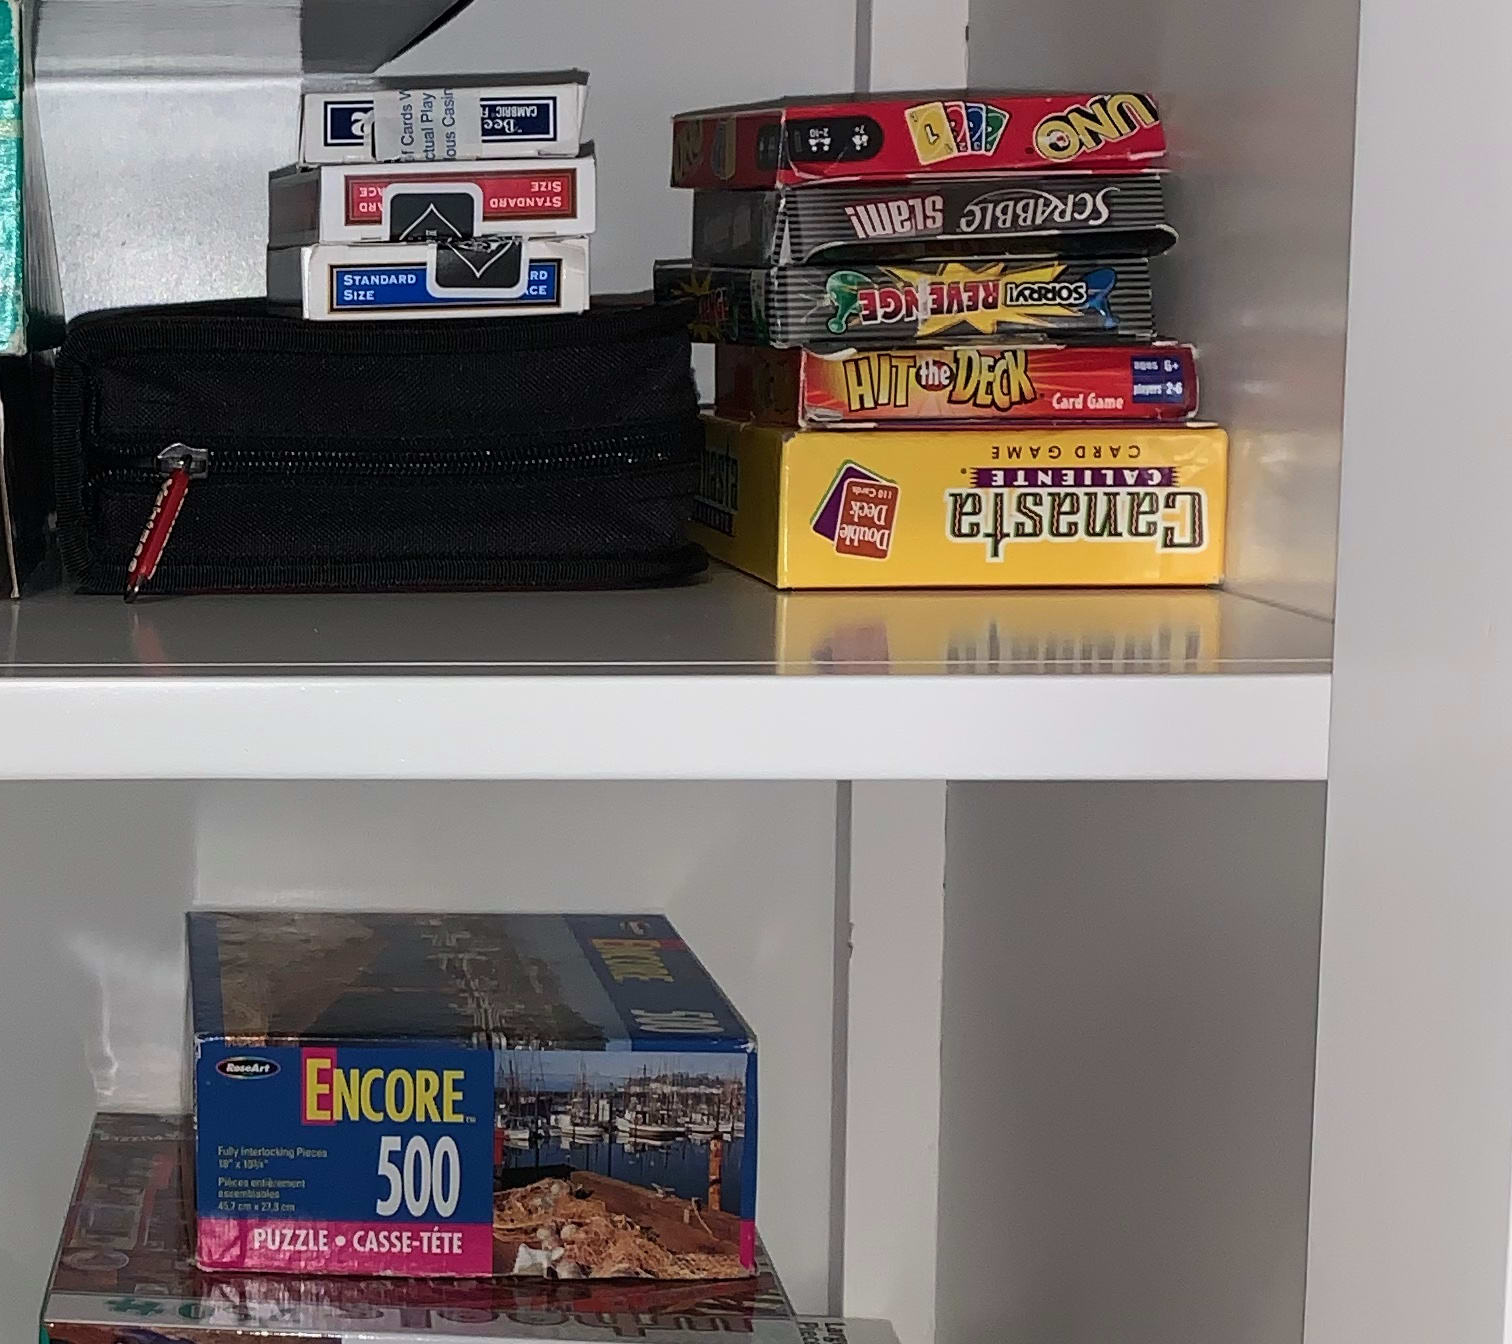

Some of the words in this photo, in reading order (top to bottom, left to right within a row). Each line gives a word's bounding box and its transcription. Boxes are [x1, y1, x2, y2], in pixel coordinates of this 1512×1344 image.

[1033, 92, 1160, 163] UNO
[530, 181, 563, 193] SIZE
[489, 195, 563, 209] STANDARD
[343, 273, 418, 287] STANDARD
[343, 289, 376, 302] SIZE
[857, 278, 1002, 327] REVENGE
[1004, 281, 1091, 309] SORRY!
[1133, 359, 1159, 374] ages
[1163, 358, 1180, 374] 6+
[842, 353, 917, 413] HIT
[919, 362, 953, 390] the
[947, 349, 1038, 412] DECK
[1133, 382, 1162, 397] players
[1165, 381, 1184, 397] 2-6
[1051, 393, 1086, 411] Card
[1087, 393, 1125, 411] Game
[989, 443, 1065, 459] GAME
[1072, 443, 1142, 459] CARD
[990, 467, 1165, 488] CALIENTE
[846, 499, 889, 525] Deck
[949, 490, 1206, 559] Canasta
[839, 523, 891, 552] Double
[224, 1061, 272, 1075] RoseArt
[304, 1057, 466, 1124] ENCORE
[375, 1134, 462, 1219] 500
[252, 1228, 329, 1253] PUZZLE
